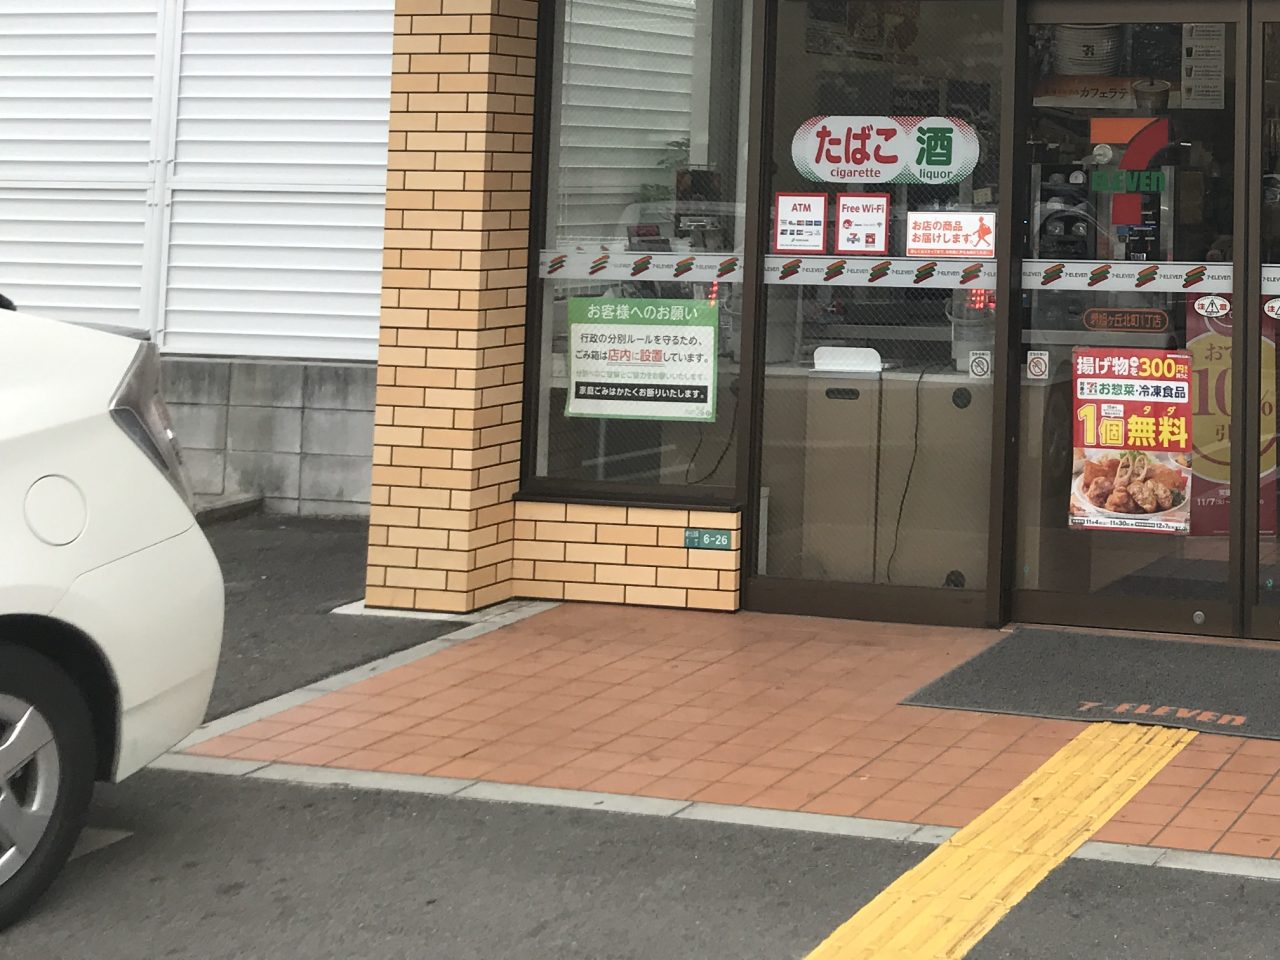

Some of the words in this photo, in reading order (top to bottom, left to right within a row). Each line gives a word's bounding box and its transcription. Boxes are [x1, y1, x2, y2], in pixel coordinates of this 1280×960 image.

[815, 124, 898, 164] たばこ
[916, 126, 954, 166] 酒
[830, 168, 881, 180] cigarette
[919, 169, 953, 180] liquor
[791, 203, 811, 212] ATM
[842, 204, 860, 213] Free
[862, 204, 884, 213] Wi-Fi
[912, 220, 963, 231] お店の商品
[587, 304, 698, 320] お客様へのお願い
[581, 333, 703, 346] 行政の分別ルールを守るため、
[575, 348, 709, 364] ごみ箱は店内に設置しています。
[1077, 356, 1129, 375] 揚げ物
[578, 386, 705, 399] 家庭ごみはかたくお断りいたします。
[1127, 414, 1188, 448] 無料
[703, 534, 728, 545] 6-26
